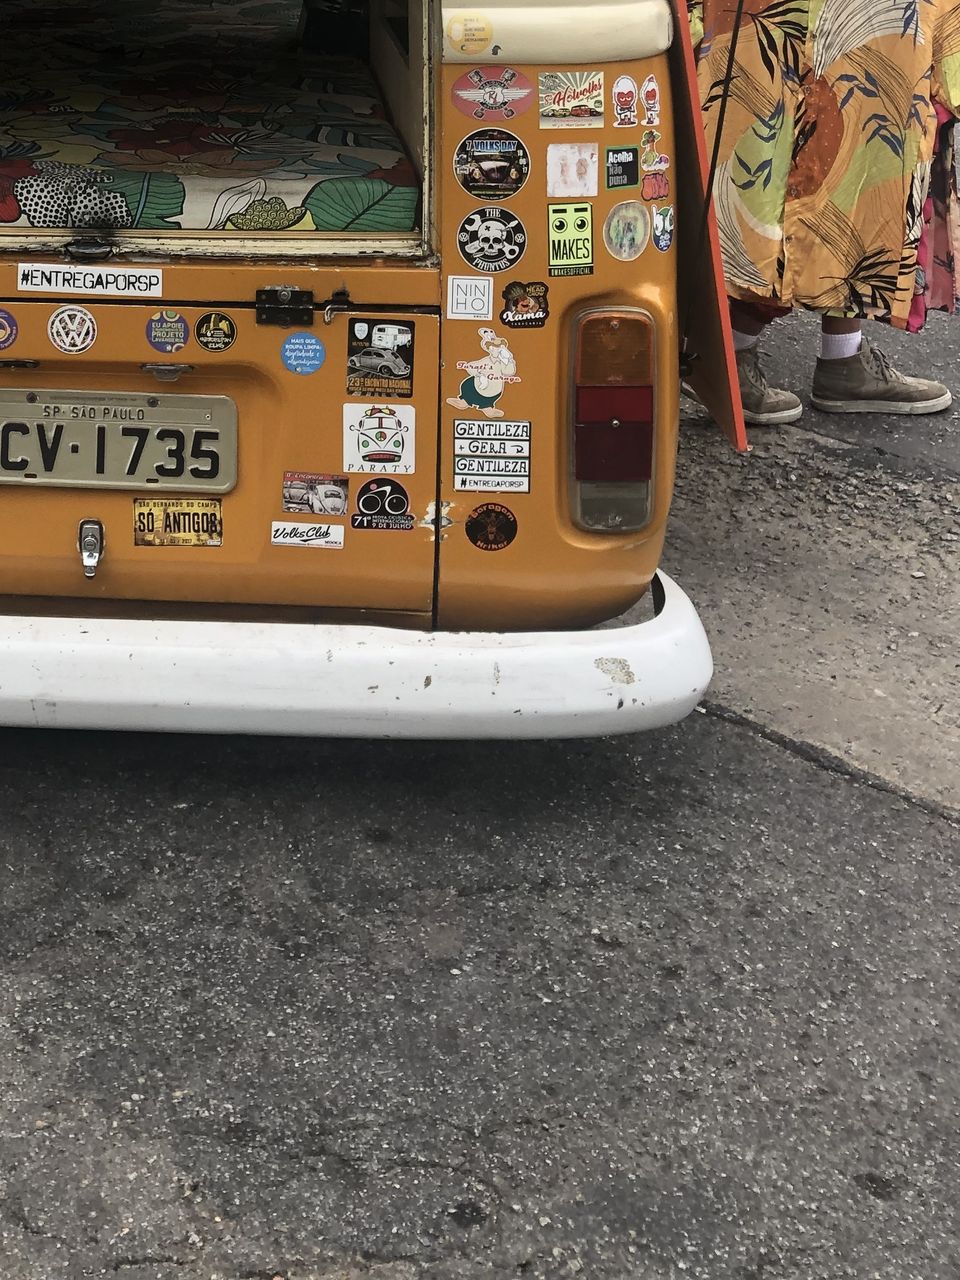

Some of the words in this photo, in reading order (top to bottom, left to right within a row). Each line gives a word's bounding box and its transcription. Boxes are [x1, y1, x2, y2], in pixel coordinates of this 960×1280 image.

[473, 140, 500, 153] VOLKS
[501, 140, 518, 152] DAY
[608, 151, 633, 164] Acolha
[485, 208, 501, 217] THE
[551, 238, 590, 261] MAKES
[20, 269, 160, 291] #ENTREGAPORSP
[456, 283, 486, 297] NIN
[456, 298, 485, 311] HO
[71, 404, 96, 419] SÃO
[103, 408, 145, 420] PAULO
[456, 422, 530, 437] GENTILEZA
[468, 440, 507, 454] GERA
[347, 464, 411, 473] PARATY
[457, 458, 528, 473] GENTILEZA
[138, 508, 155, 533] SÓ
[164, 512, 218, 534] ANTIGOS
